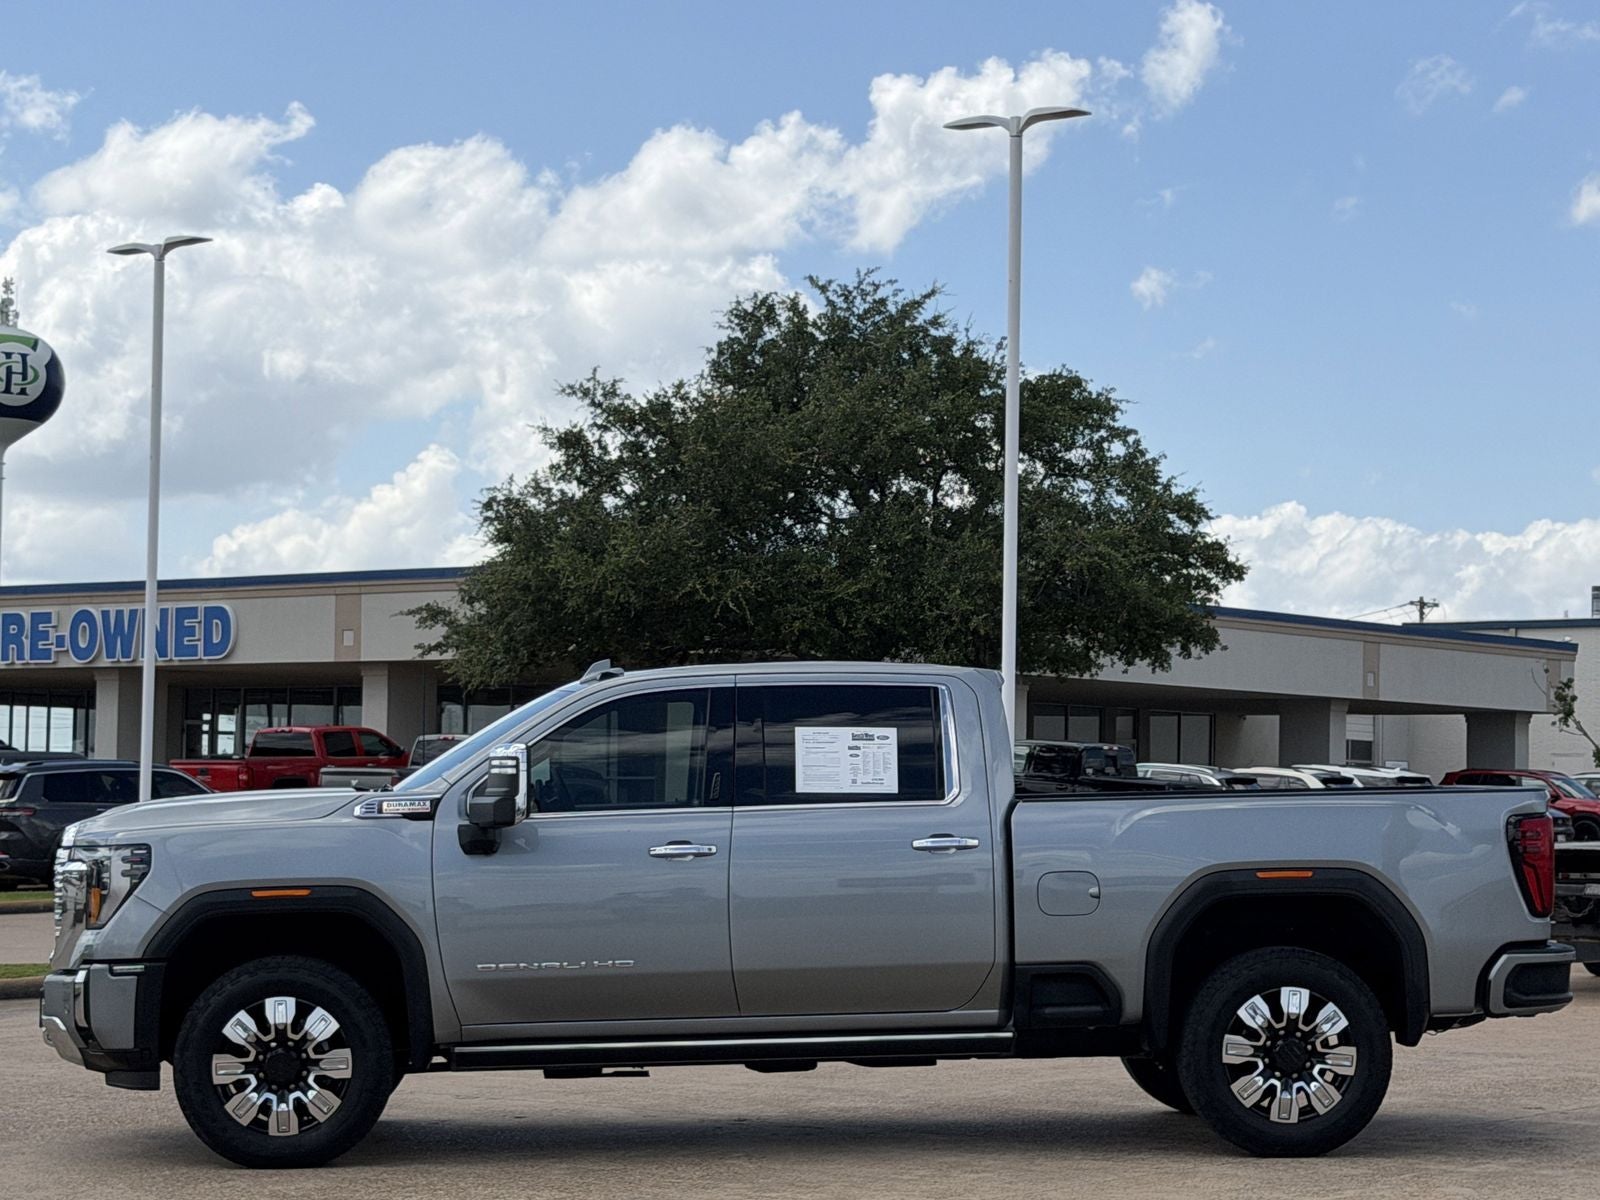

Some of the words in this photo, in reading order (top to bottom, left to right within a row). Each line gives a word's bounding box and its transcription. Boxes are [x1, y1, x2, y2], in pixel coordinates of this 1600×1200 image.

[0, 603, 236, 664] RE-OWNED
[476, 961, 587, 971] DENALI
[593, 959, 634, 967] HD
